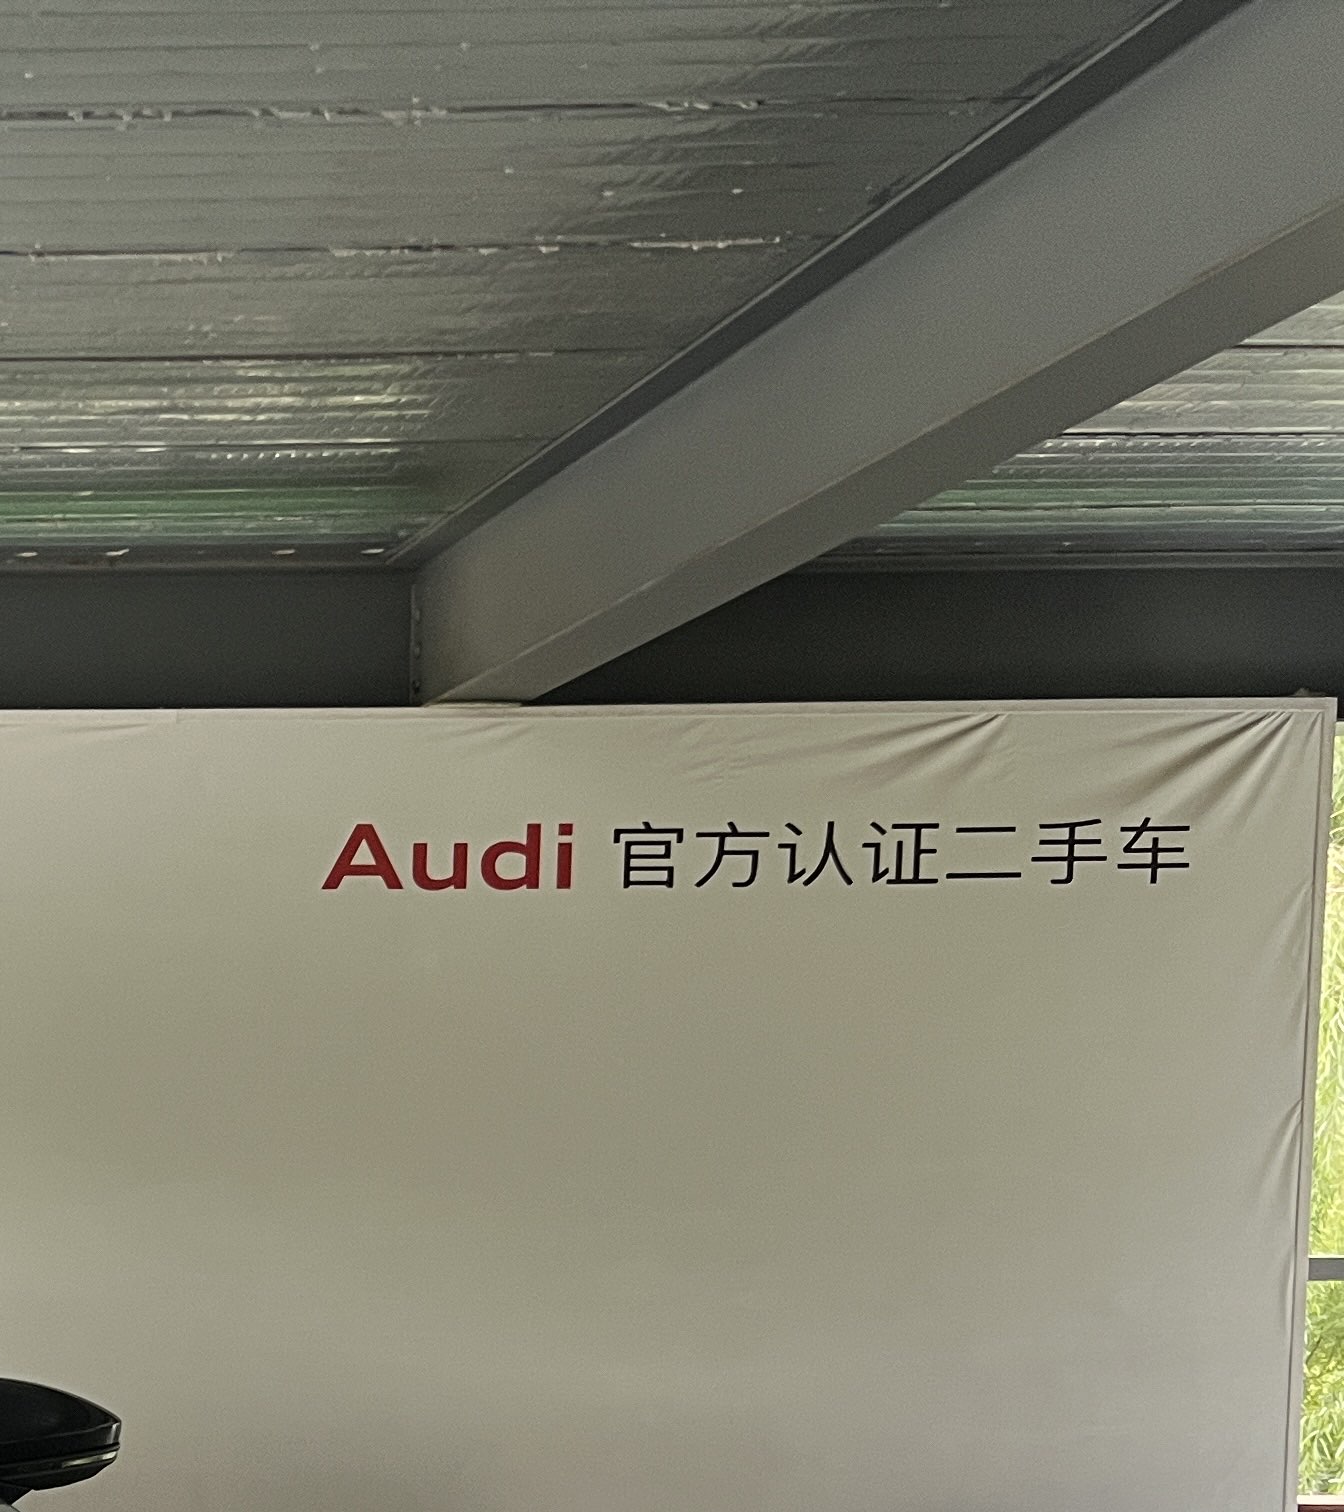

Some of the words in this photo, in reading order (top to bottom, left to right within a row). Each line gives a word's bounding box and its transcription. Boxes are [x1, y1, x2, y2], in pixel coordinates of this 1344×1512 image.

[322, 823, 575, 891] Audi
[612, 817, 1192, 890] 官方认证二手车
